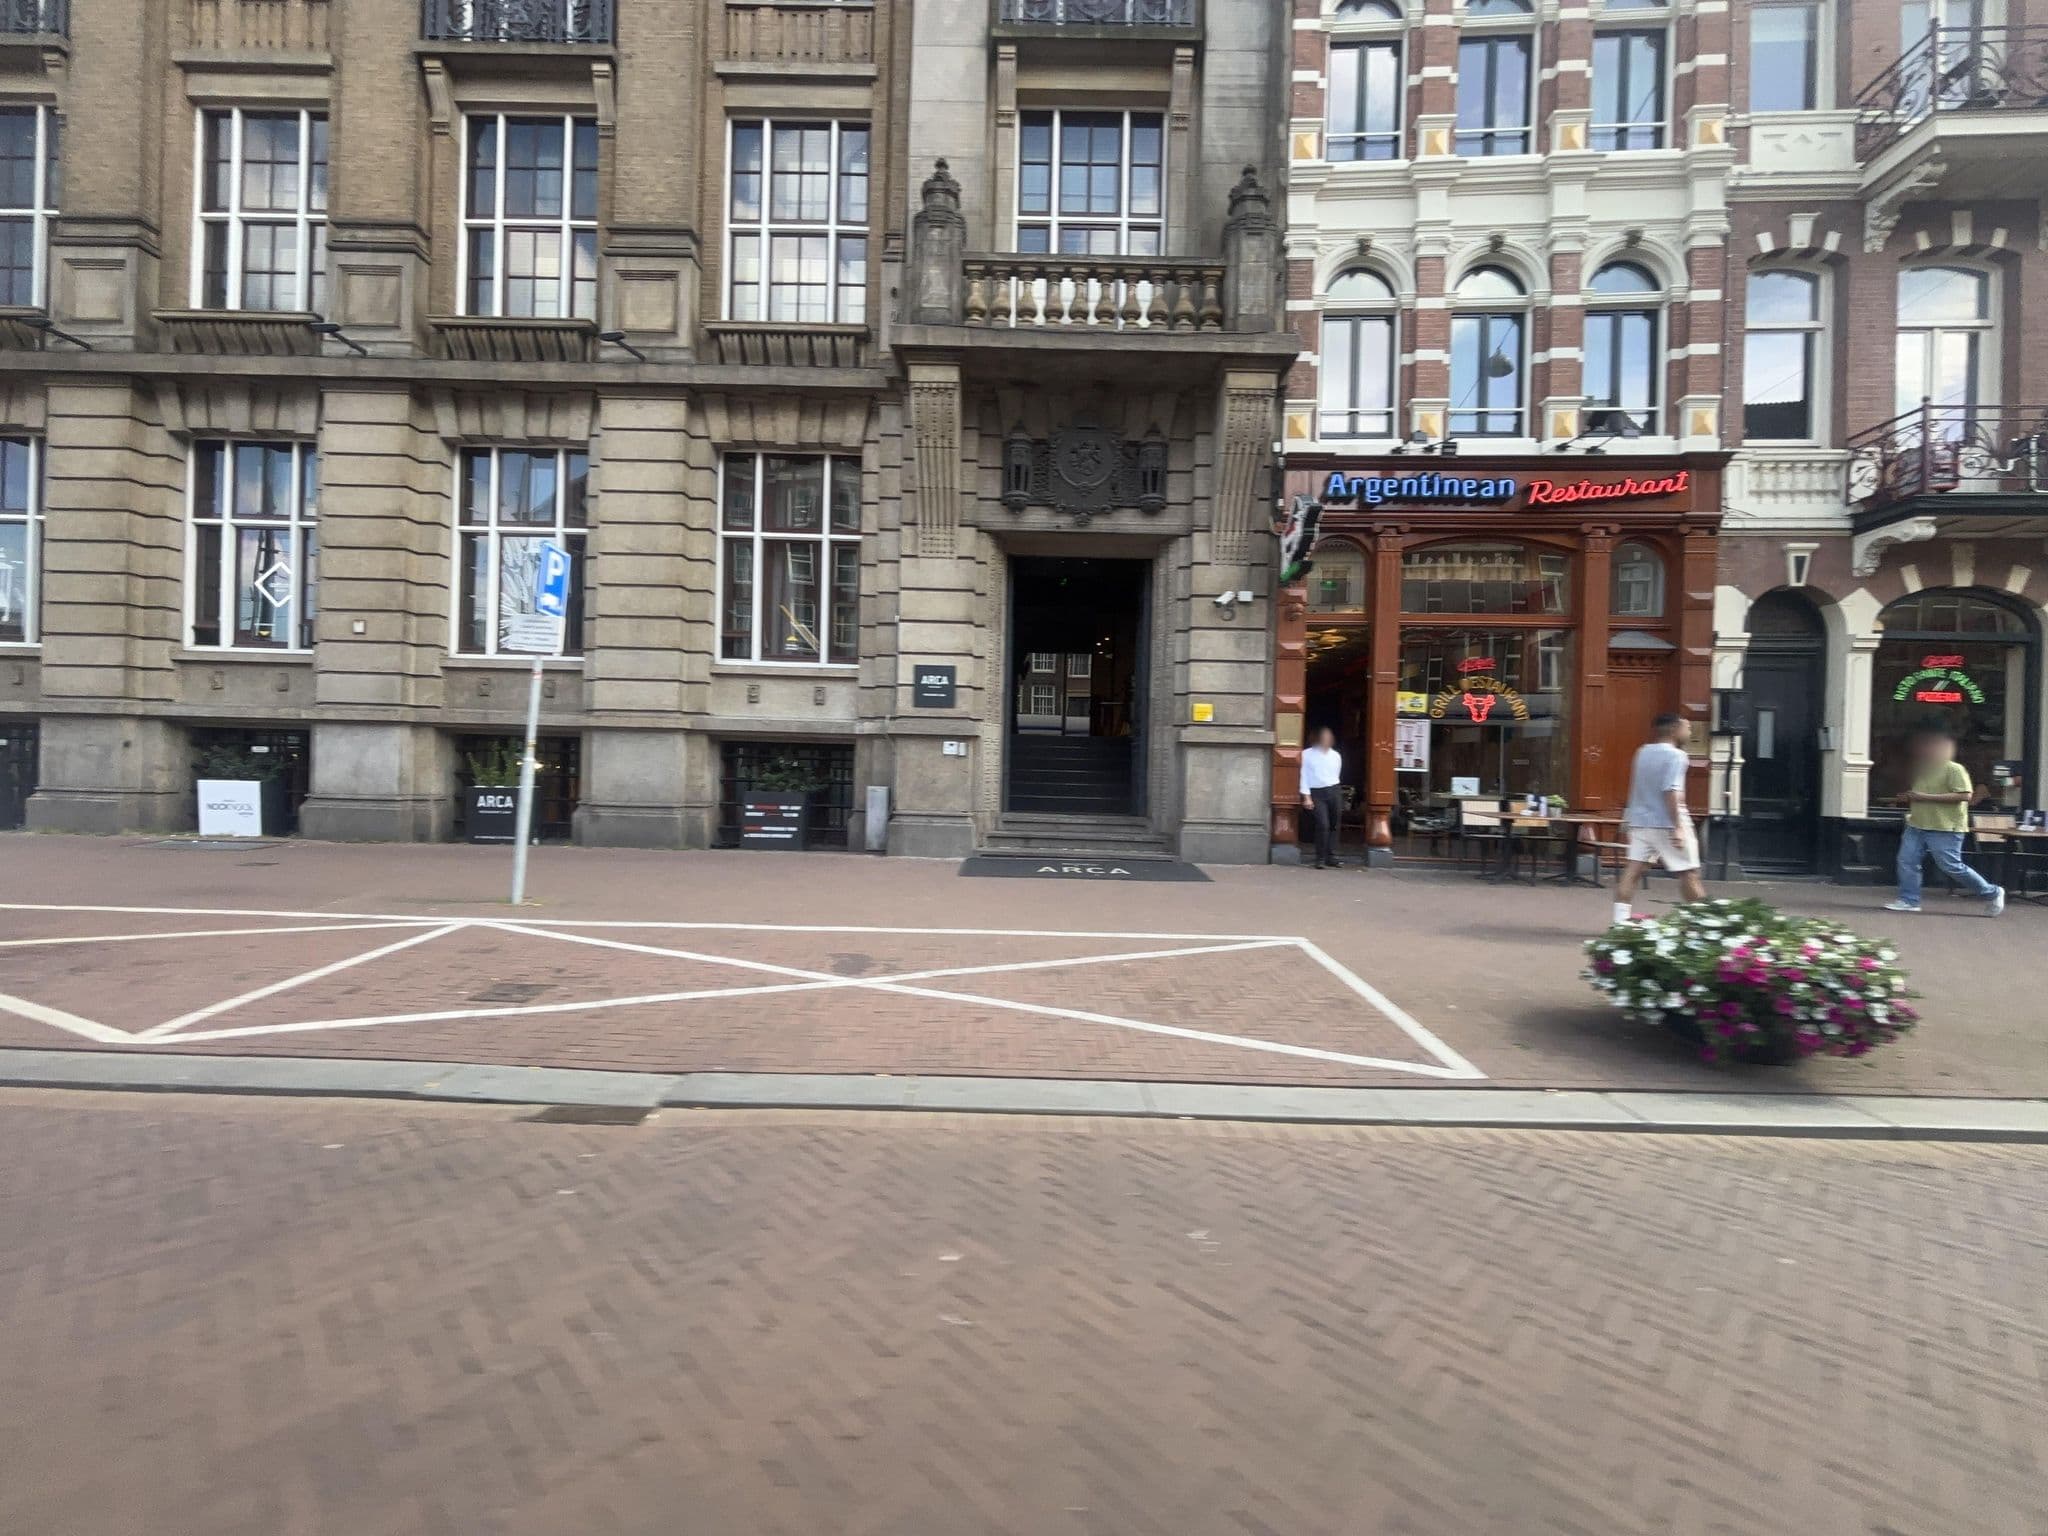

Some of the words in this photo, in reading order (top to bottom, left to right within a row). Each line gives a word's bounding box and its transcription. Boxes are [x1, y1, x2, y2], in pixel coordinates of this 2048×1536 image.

[1327, 473, 1516, 503] Argentinean
[1528, 471, 1688, 504] Restaurant
[547, 550, 565, 586] P
[920, 675, 949, 685] ARCA
[1430, 685, 1461, 718] GRILL
[476, 795, 514, 808] ARCA
[1036, 865, 1131, 875] ARCA
